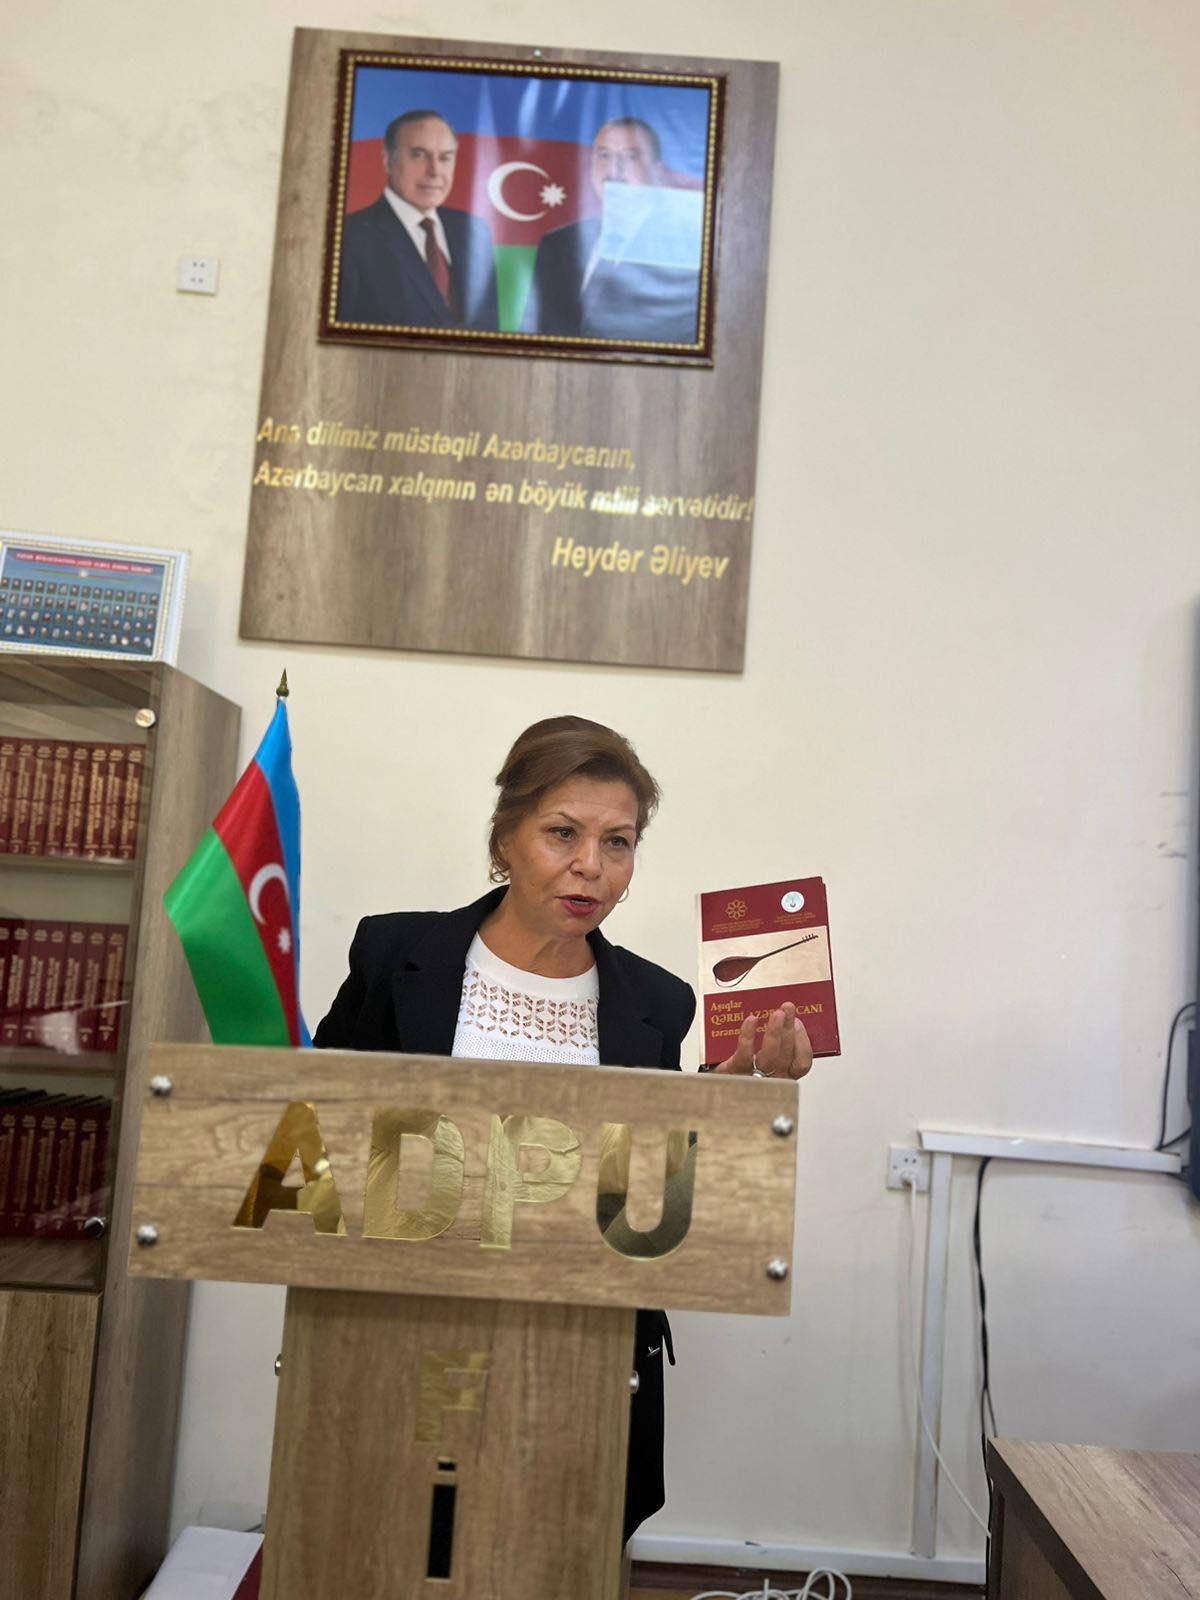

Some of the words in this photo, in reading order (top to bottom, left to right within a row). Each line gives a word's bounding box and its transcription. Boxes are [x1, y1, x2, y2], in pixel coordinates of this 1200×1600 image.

[306, 421, 379, 450] dilimiz
[383, 426, 480, 462] müstəqil
[482, 433, 636, 473] Azərbaycanın,
[254, 460, 384, 497] Azərbaycan
[388, 472, 476, 504] xalqının
[485, 484, 513, 503] ən
[517, 479, 589, 514] böyük
[550, 536, 645, 577] Heydər
[650, 543, 730, 586] Əliyev
[231, 1100, 698, 1261] ADPU
